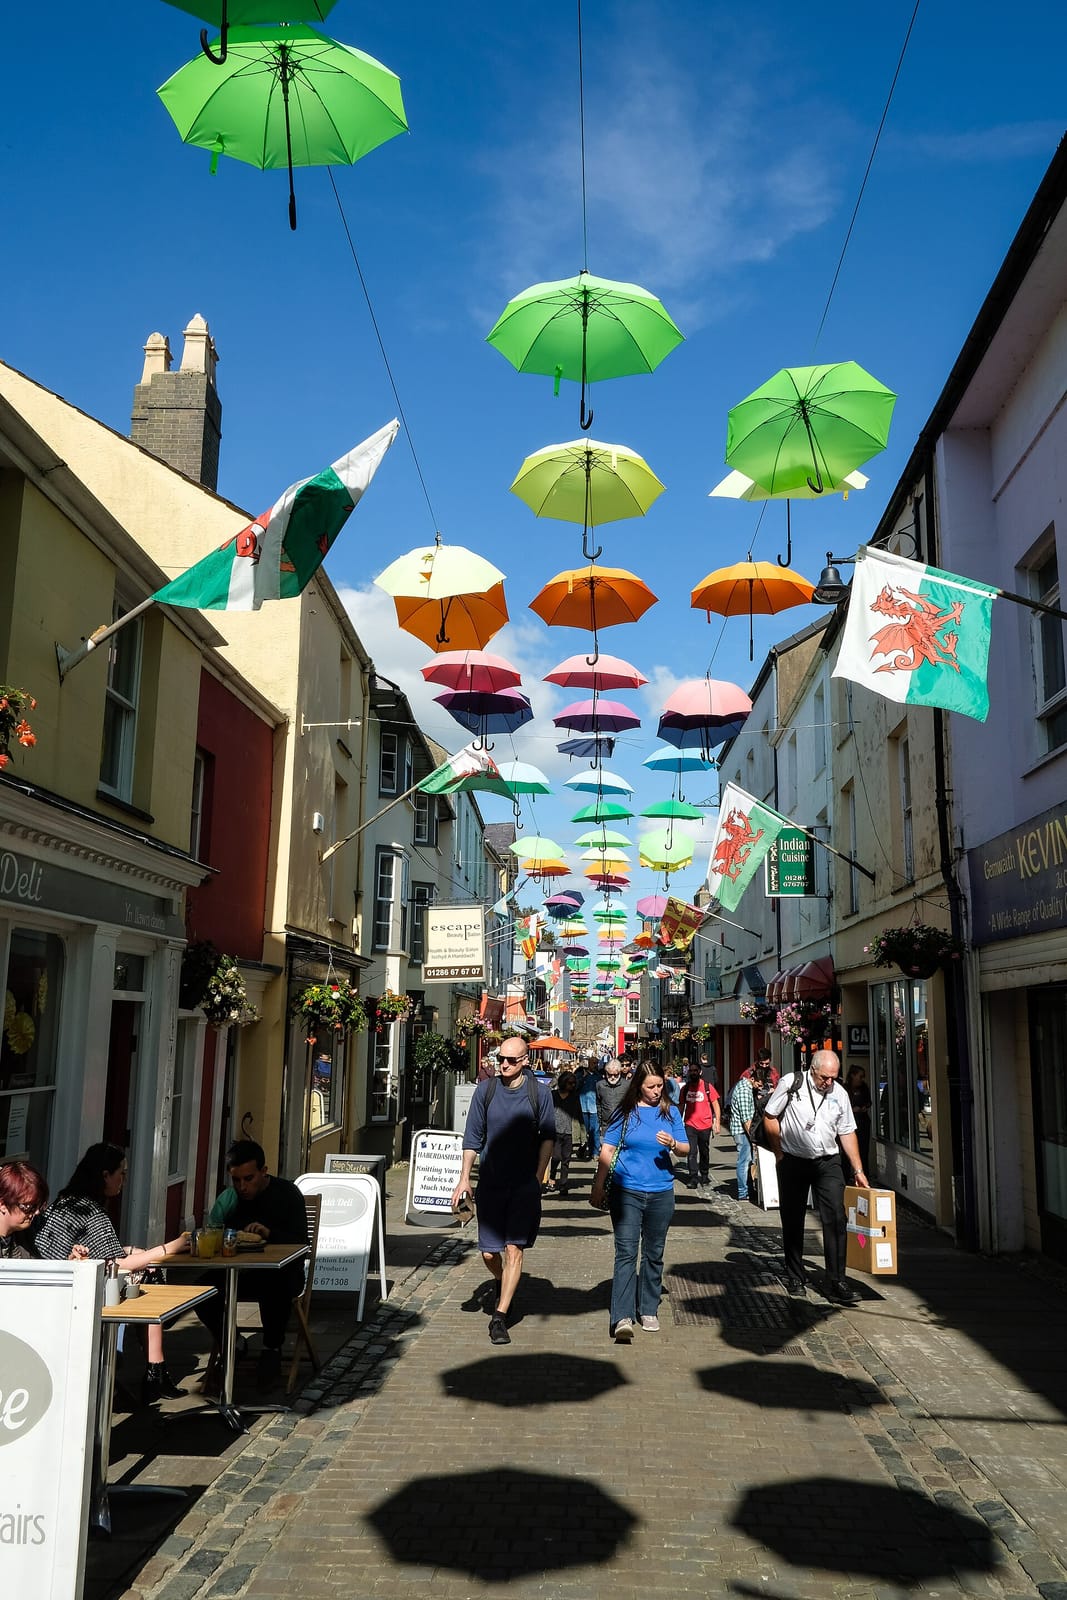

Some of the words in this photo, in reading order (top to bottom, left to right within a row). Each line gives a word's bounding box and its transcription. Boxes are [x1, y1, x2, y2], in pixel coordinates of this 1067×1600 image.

[780, 838, 810, 851] Indian
[781, 851, 809, 863] Cuisine
[984, 848, 1016, 879] Gemwaith
[0, 852, 42, 901] Deli
[996, 908, 1012, 931] Wide
[1013, 907, 1032, 928] Range
[1032, 900, 1039, 920] of
[1039, 894, 1063, 920] Quality
[430, 923, 481, 940] escape
[427, 969, 449, 977] 01286
[450, 968, 459, 976] 67
[460, 968, 470, 976] 67
[851, 1027, 869, 1043] CA
[431, 1142, 451, 1151] YLP
[415, 1166, 443, 1174] Knitting
[423, 1175, 447, 1183] Fabrics
[414, 1196, 435, 1204] 01286
[435, 1198, 453, 1206] 6782
[318, 1264, 348, 1272] Products
[320, 1277, 349, 1286] 671308
